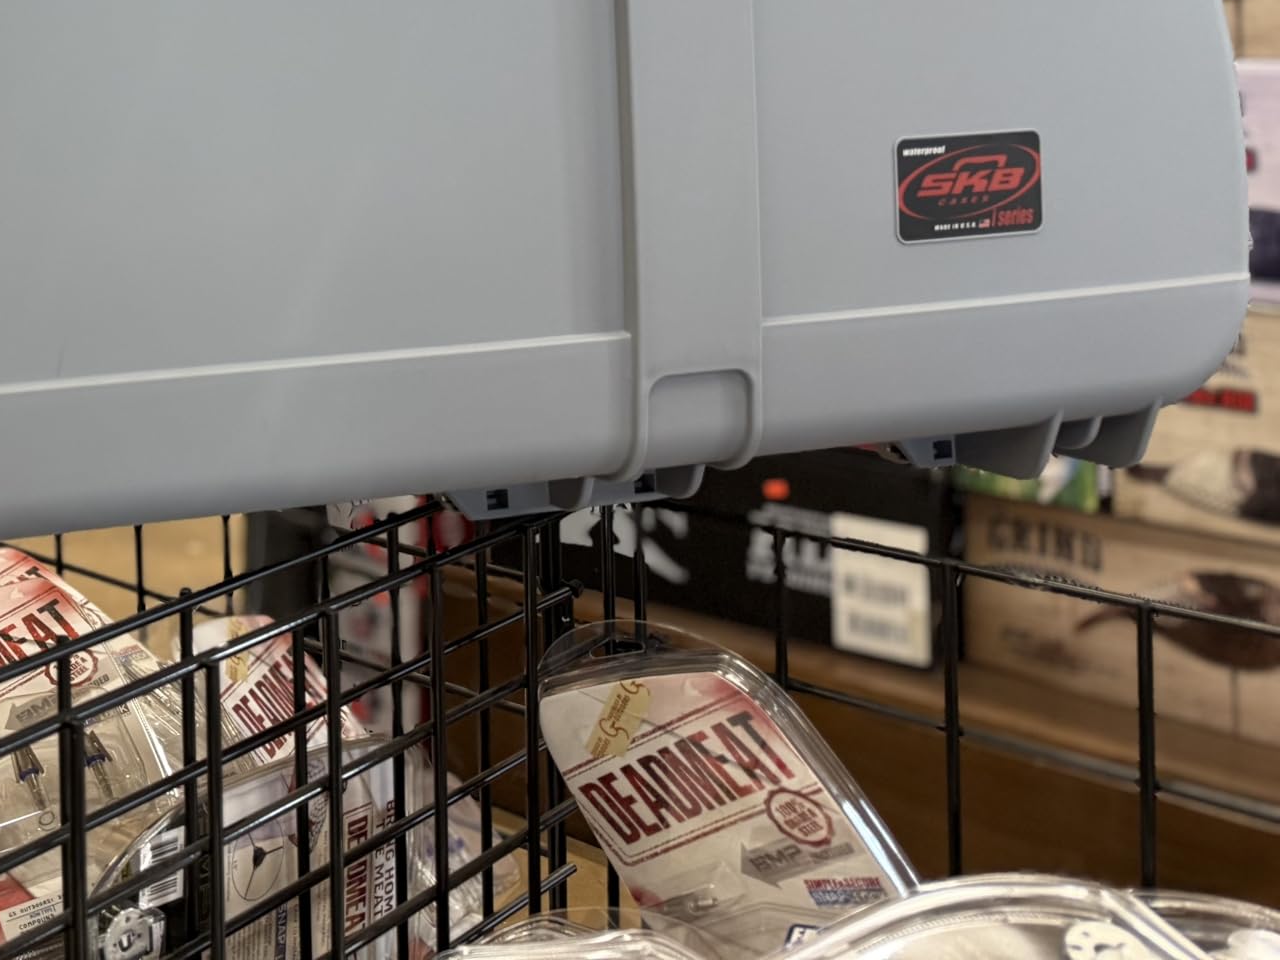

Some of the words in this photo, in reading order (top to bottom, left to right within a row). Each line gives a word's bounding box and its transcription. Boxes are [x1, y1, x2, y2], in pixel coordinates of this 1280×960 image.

[903, 145, 946, 156] waterproof
[916, 167, 1025, 197] SKB
[232, 649, 304, 760] DEADMEA
[577, 710, 796, 846] DEADMEAT
[344, 814, 370, 936] DEDMEA
[373, 864, 386, 918] MEAT
